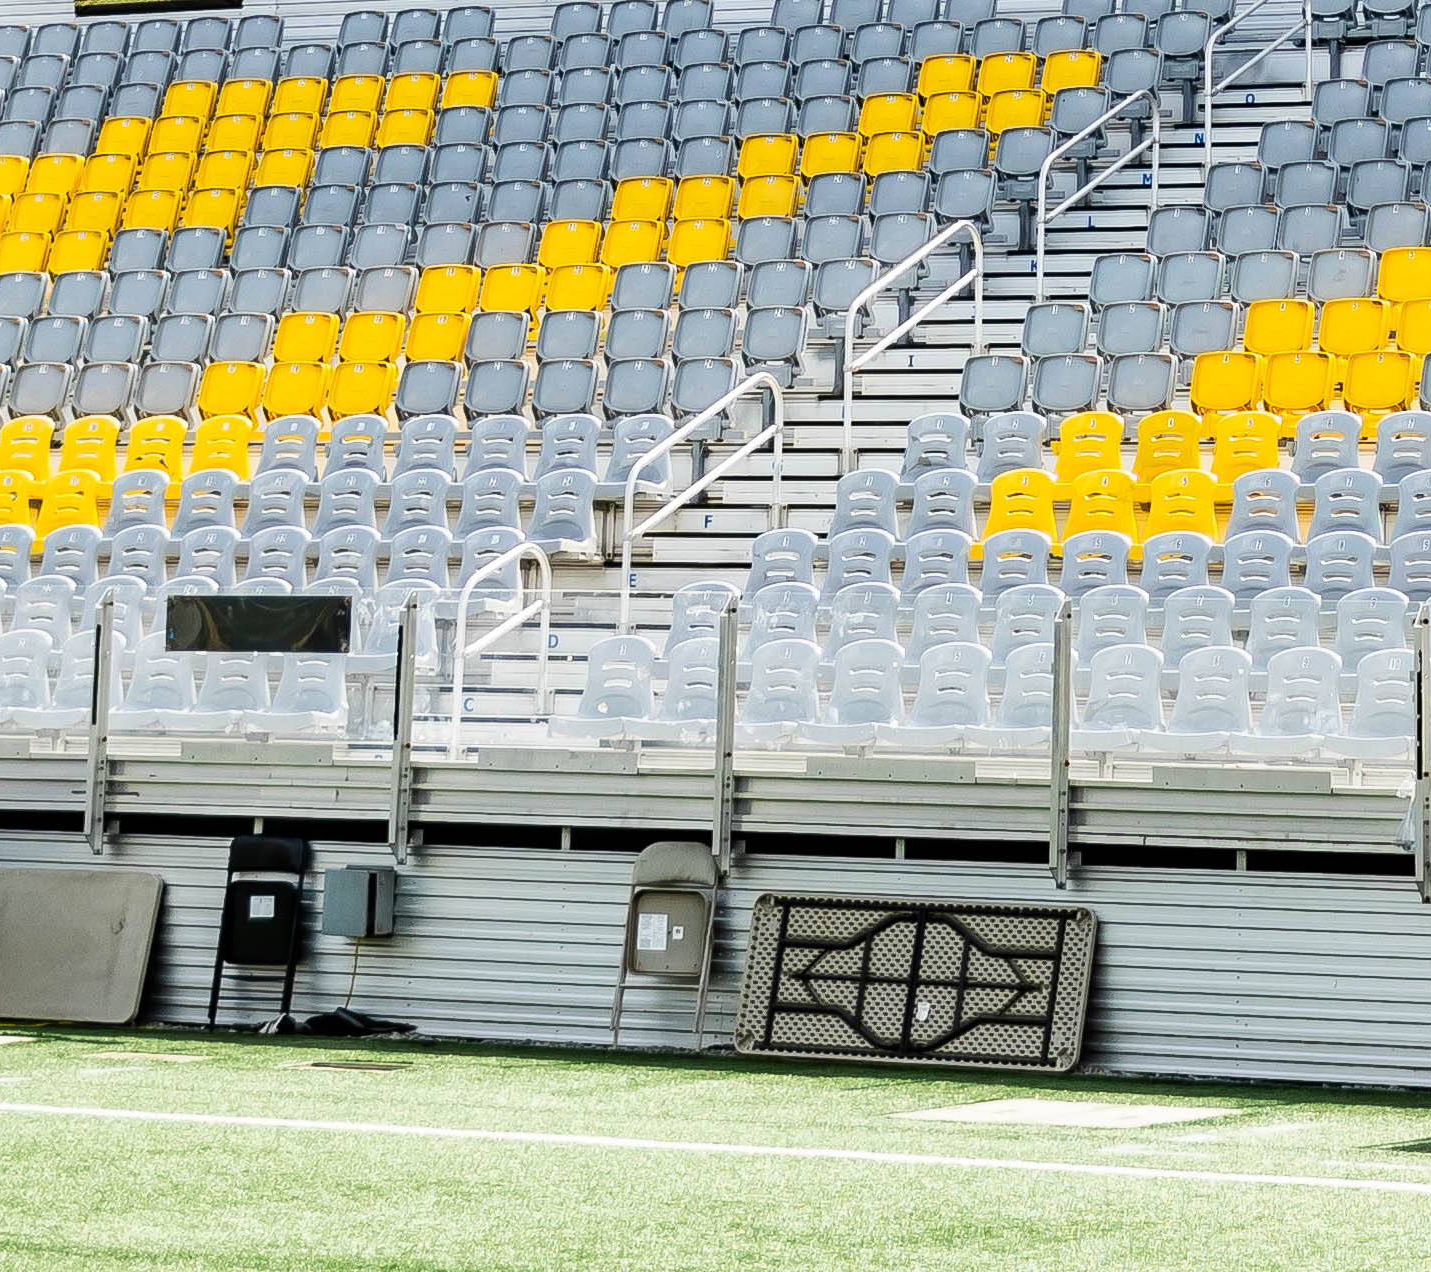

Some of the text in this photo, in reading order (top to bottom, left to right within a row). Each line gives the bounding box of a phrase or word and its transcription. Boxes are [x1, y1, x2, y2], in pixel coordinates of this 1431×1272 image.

[1193, 133, 1204, 144] N
[908, 355, 914, 367] I
[704, 515, 713, 528] F
[629, 574, 637, 587] E
[548, 635, 558, 648] D
[464, 698, 474, 712] C
